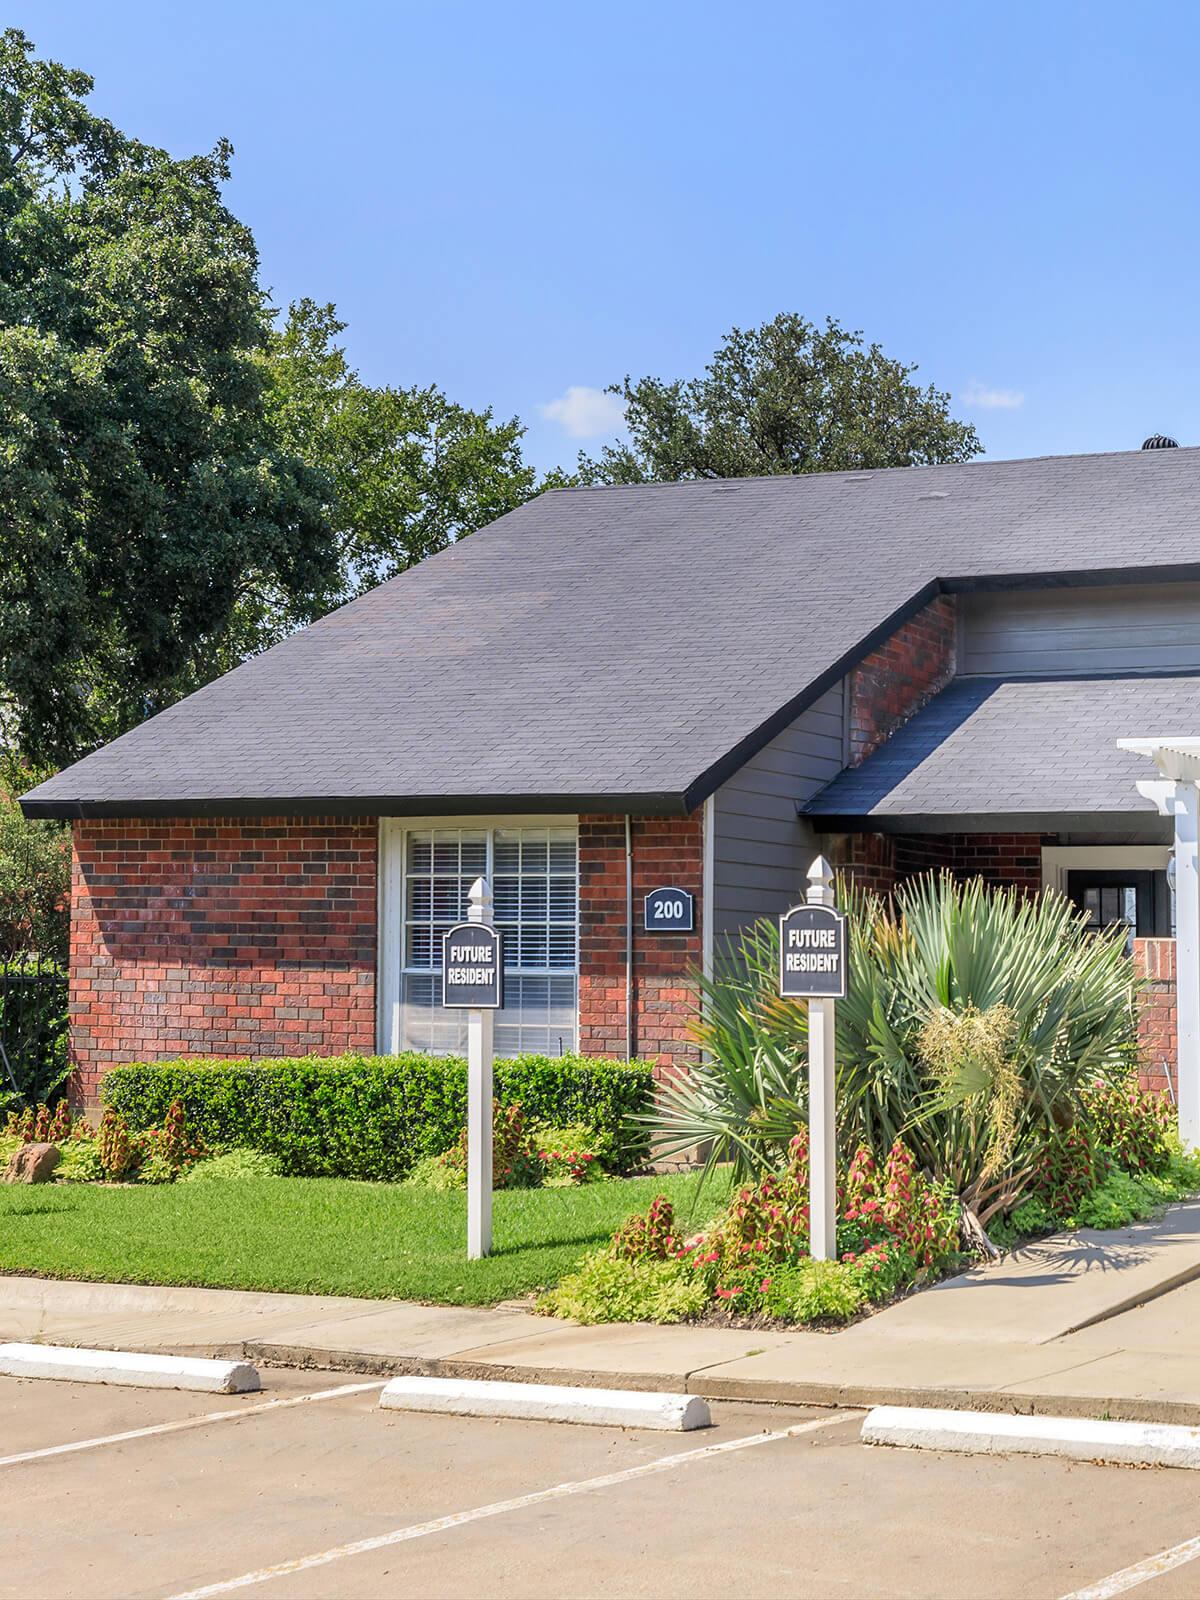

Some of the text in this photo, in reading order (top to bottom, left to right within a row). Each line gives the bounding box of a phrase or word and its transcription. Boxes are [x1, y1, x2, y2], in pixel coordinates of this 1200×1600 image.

[653, 900, 683, 919] 200
[788, 928, 835, 948] FUTURE
[450, 945, 492, 963] FUTURE
[786, 953, 839, 973] RESIDENT
[448, 968, 495, 985] RESIDENT
